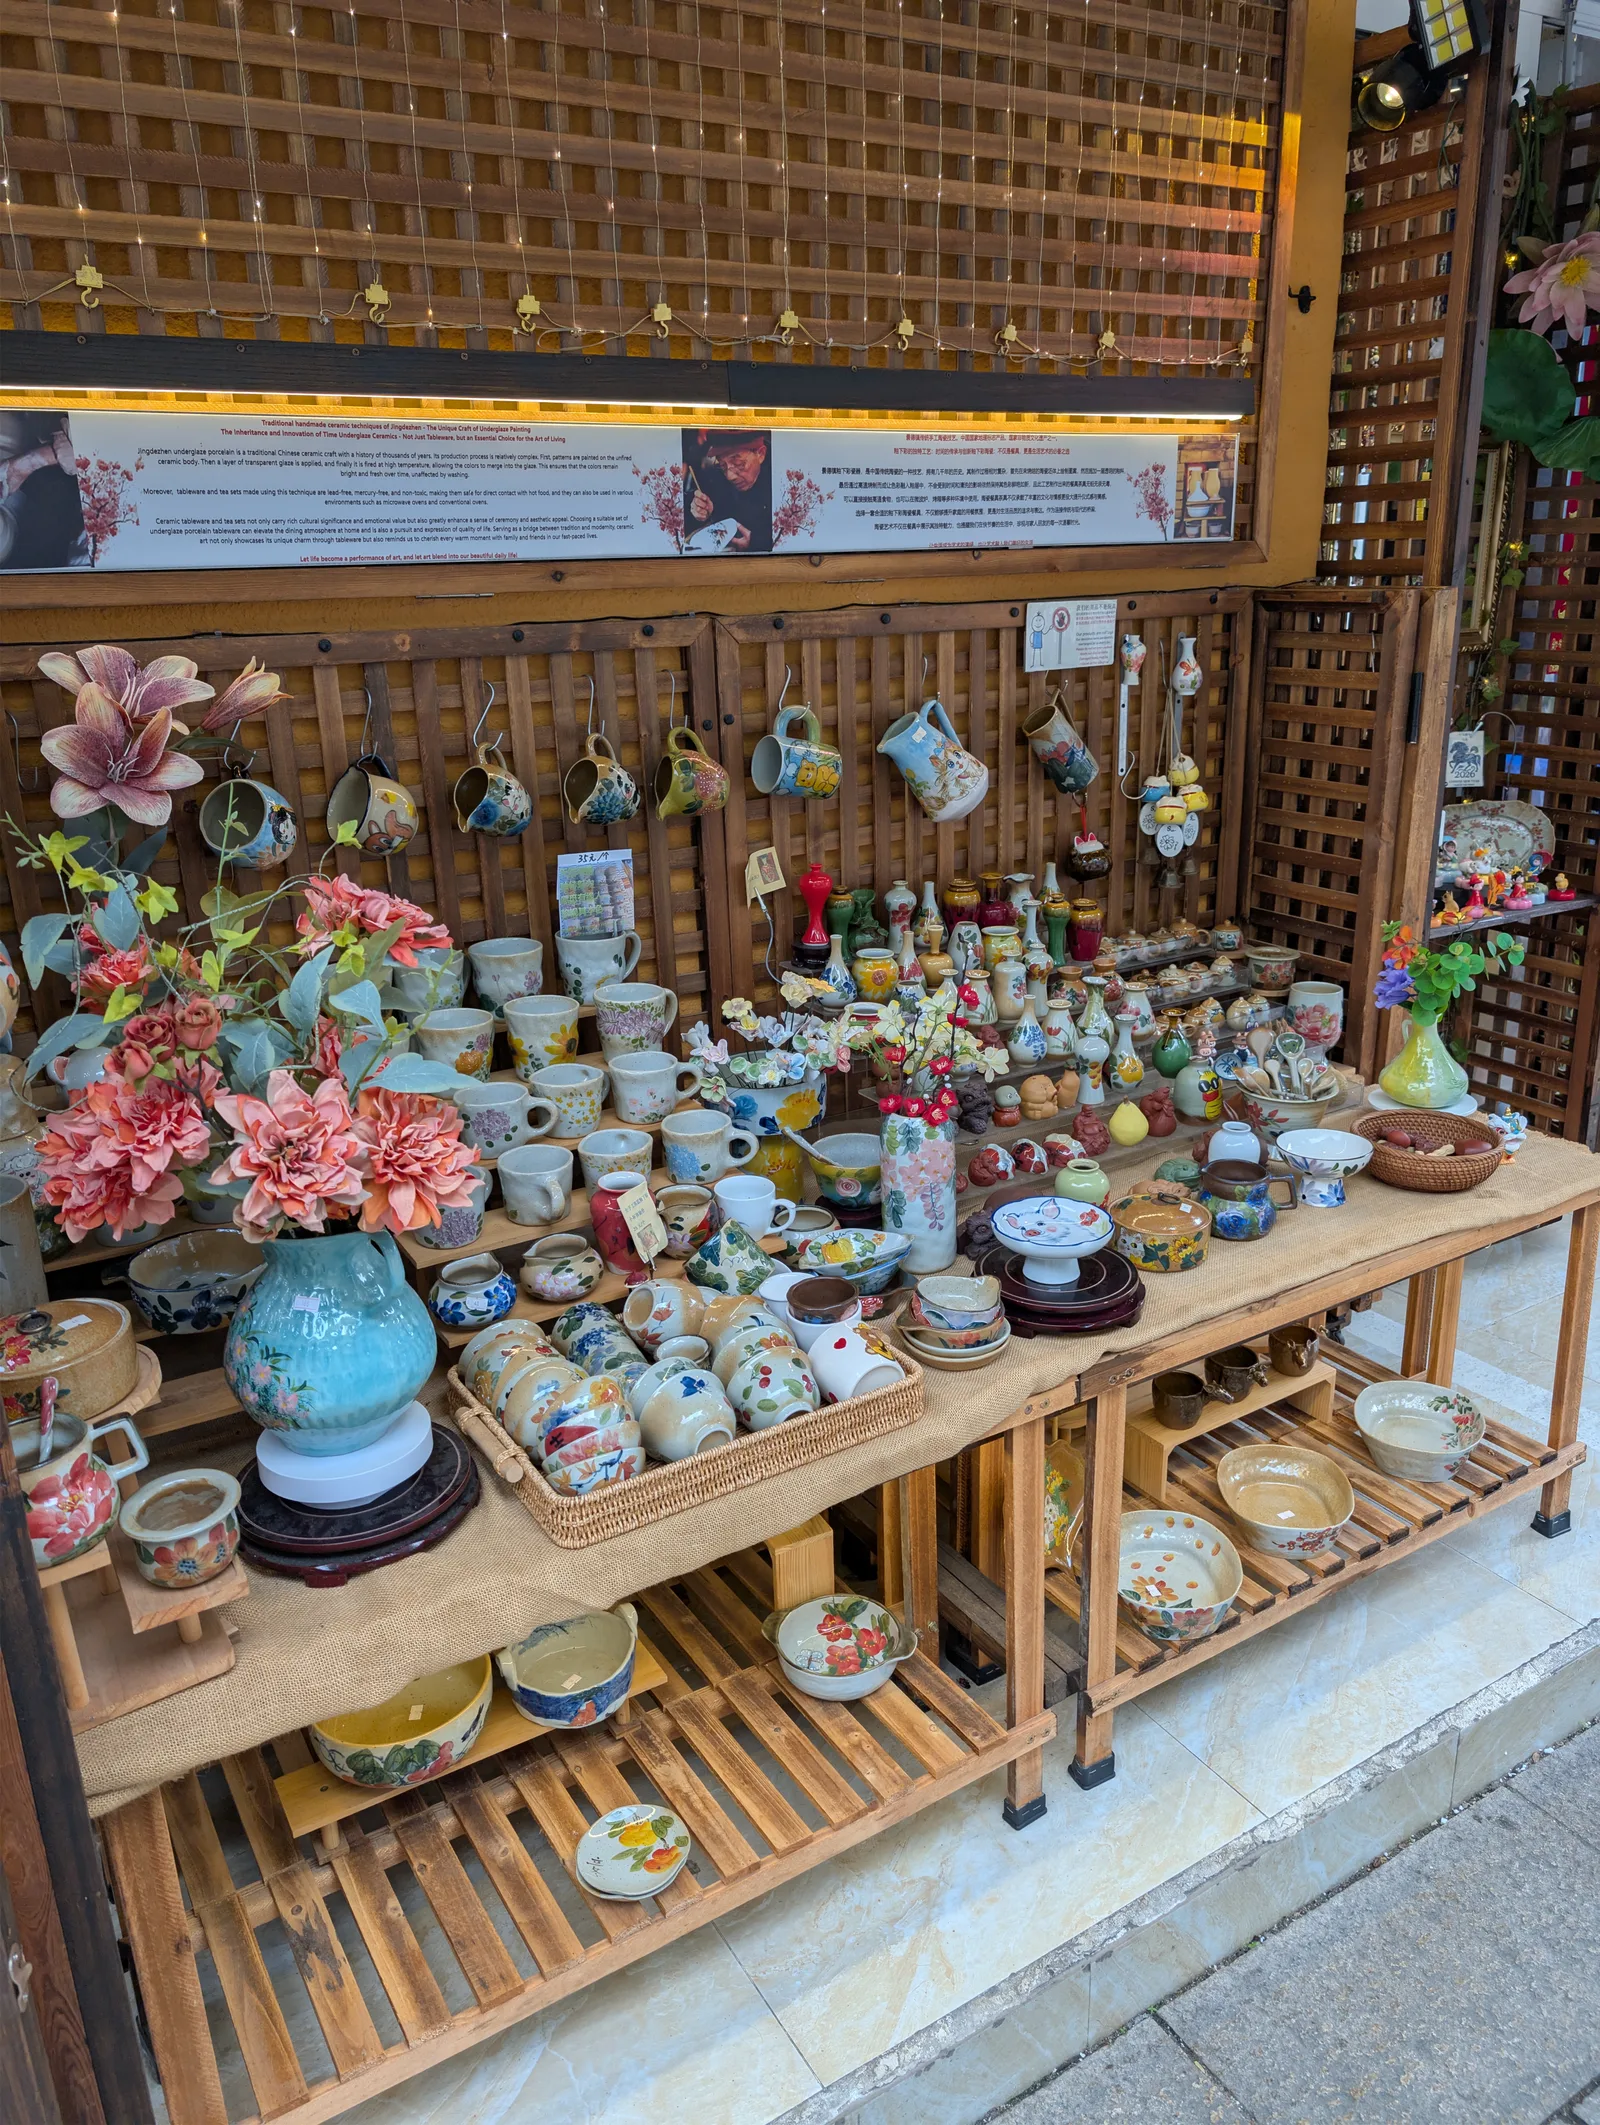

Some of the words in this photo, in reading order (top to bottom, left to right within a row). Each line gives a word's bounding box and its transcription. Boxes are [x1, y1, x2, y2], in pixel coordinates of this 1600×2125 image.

[351, 422, 381, 430] techniques
[390, 423, 421, 432] Jingdezhen
[438, 424, 456, 432] Unique
[479, 425, 508, 433] Underglaze
[509, 425, 531, 434] Painting
[338, 431, 370, 440] Underglaze
[550, 435, 566, 443] Living
[137, 446, 171, 455] Jingdezhen
[173, 447, 206, 456] underglaze
[208, 448, 234, 456] porcelain
[355, 451, 374, 459] history
[440, 452, 468, 460] production
[494, 452, 516, 461] relatively
[552, 453, 571, 462] patterns
[581, 454, 598, 462] painted
[222, 458, 236, 466] layer
[244, 458, 277, 467] transparent
[278, 459, 293, 467] glaze
[336, 460, 352, 468] finally
[384, 460, 396, 469] high
[432, 461, 453, 469] allowing
[340, 470, 356, 478] bright
[578, 852, 609, 863] 35元/个
